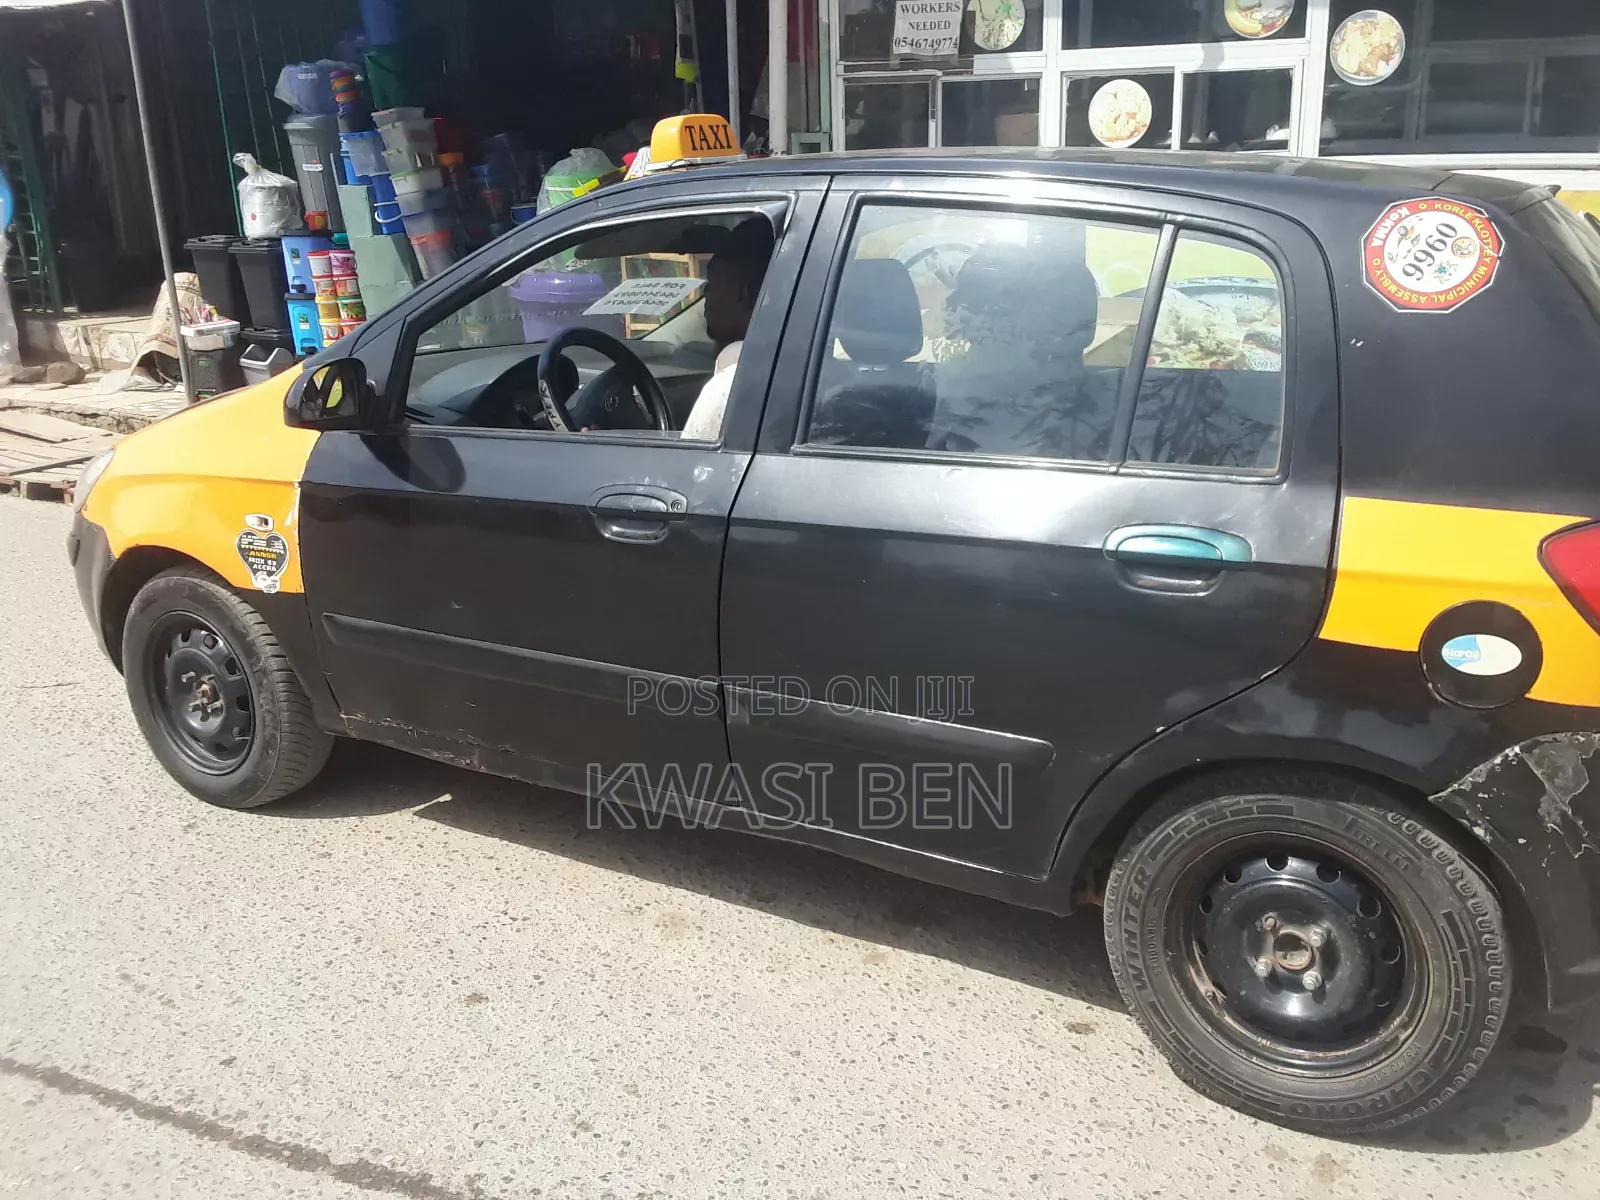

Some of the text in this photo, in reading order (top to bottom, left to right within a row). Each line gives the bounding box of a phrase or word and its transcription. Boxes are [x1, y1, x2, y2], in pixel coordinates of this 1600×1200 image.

[900, 2, 961, 14] WORKERS
[908, 20, 951, 31] NEEDED
[894, 36, 959, 50] 0546749774
[684, 124, 733, 151] TAXI
[1434, 202, 1475, 220] KORLE
[1402, 222, 1458, 281] 9960
[1374, 268, 1428, 304] ASSEMBLY
[1431, 265, 1488, 304] MUNICIPAL
[1122, 864, 1152, 992] WINTER
